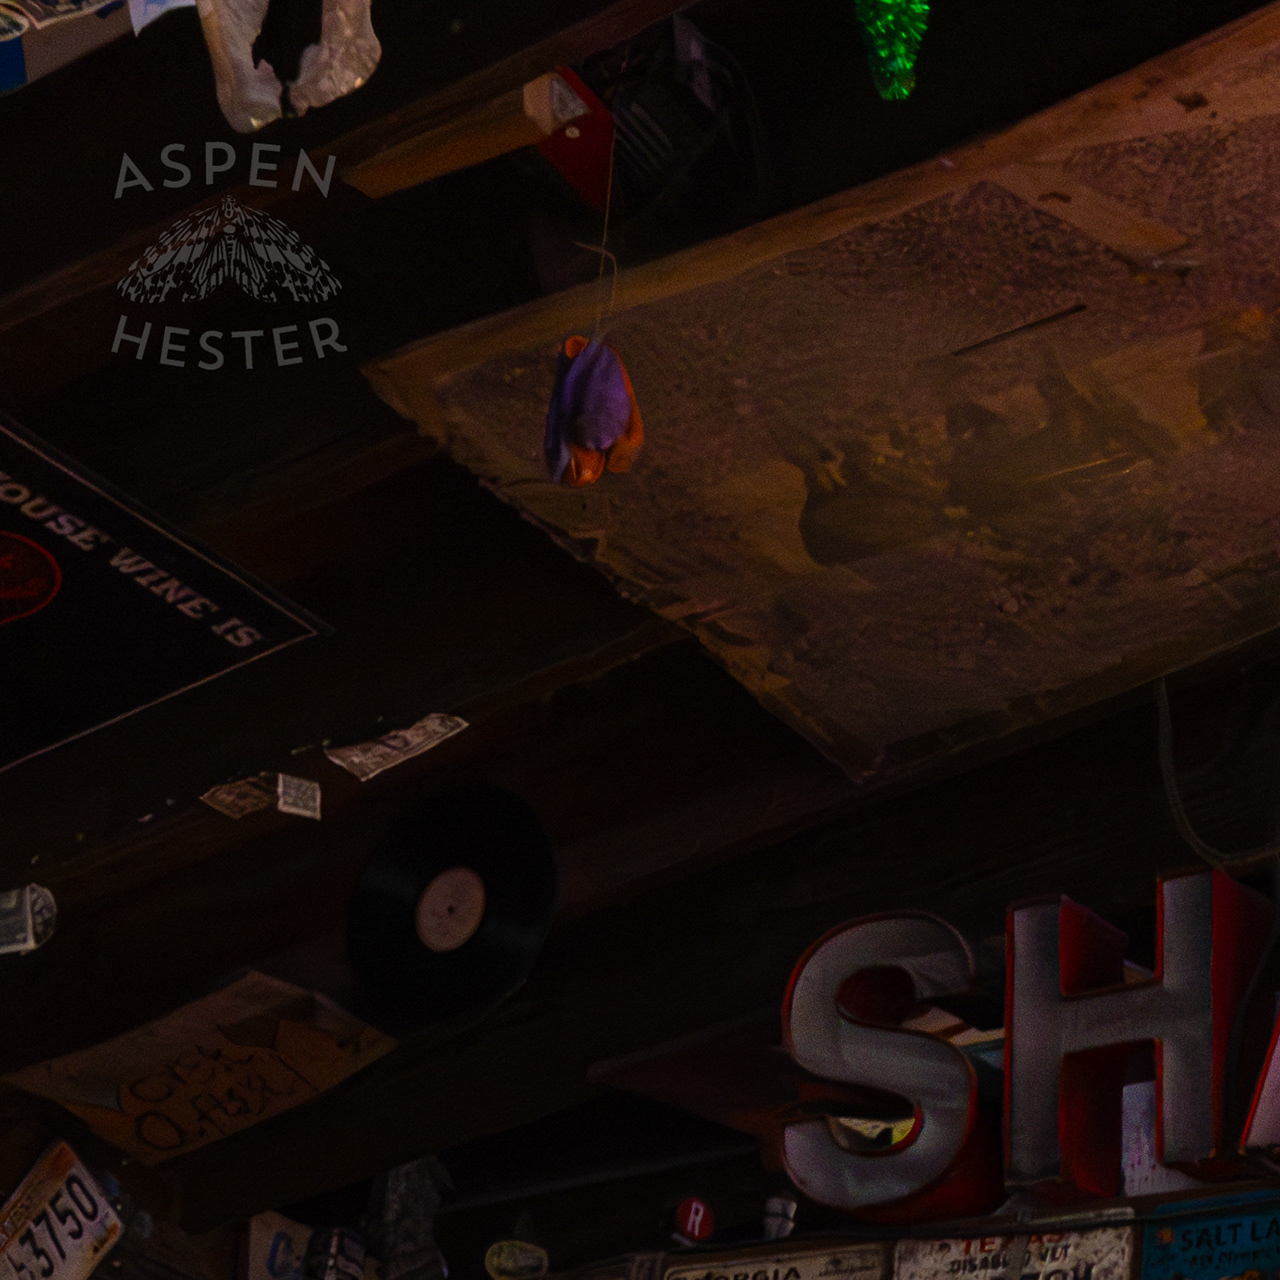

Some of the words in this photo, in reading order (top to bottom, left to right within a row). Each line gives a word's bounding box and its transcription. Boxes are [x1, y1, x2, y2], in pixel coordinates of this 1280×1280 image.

[0, 470, 112, 551] OUSE
[108, 547, 220, 619] WINE
[211, 617, 264, 648] IS
[1181, 1225, 1244, 1252] SALT
